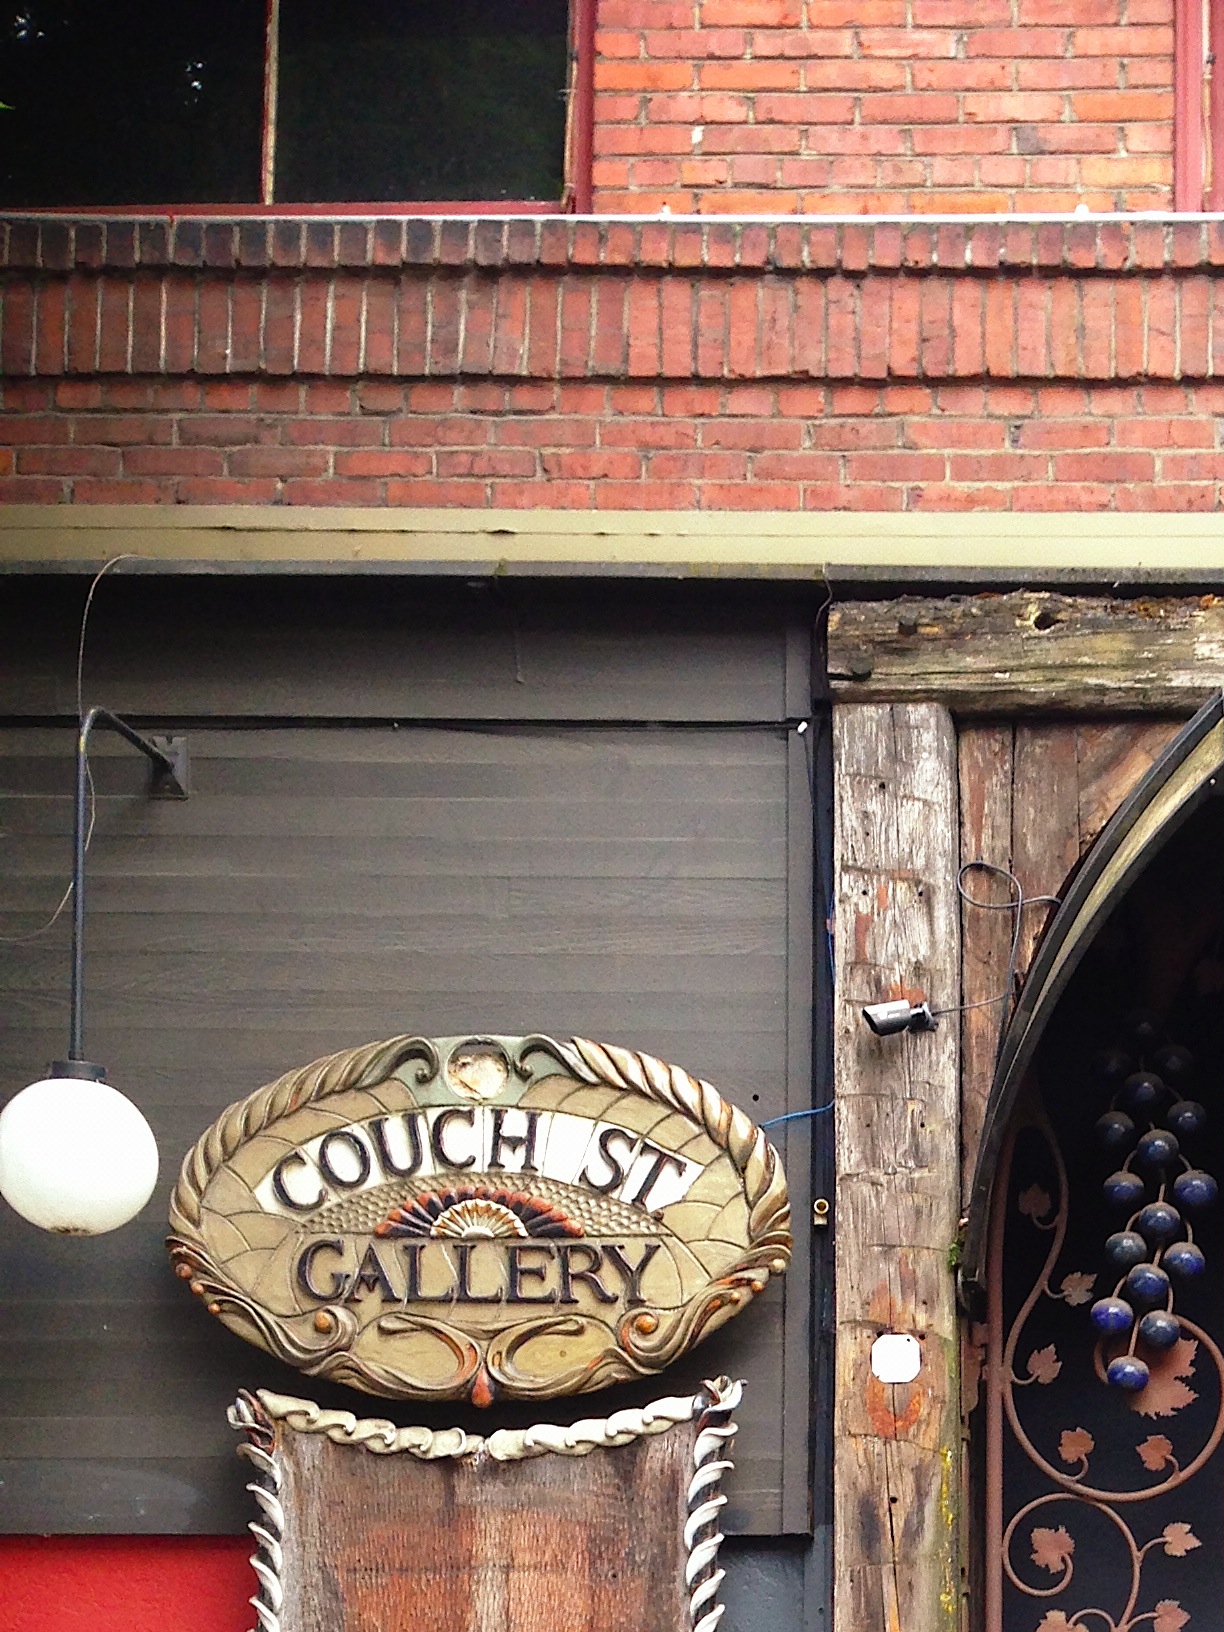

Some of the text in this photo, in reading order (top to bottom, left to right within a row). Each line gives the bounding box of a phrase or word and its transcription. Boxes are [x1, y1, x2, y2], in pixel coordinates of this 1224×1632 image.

[272, 1108, 687, 1213] COUCH ST
[296, 1239, 661, 1305] GALLERY
